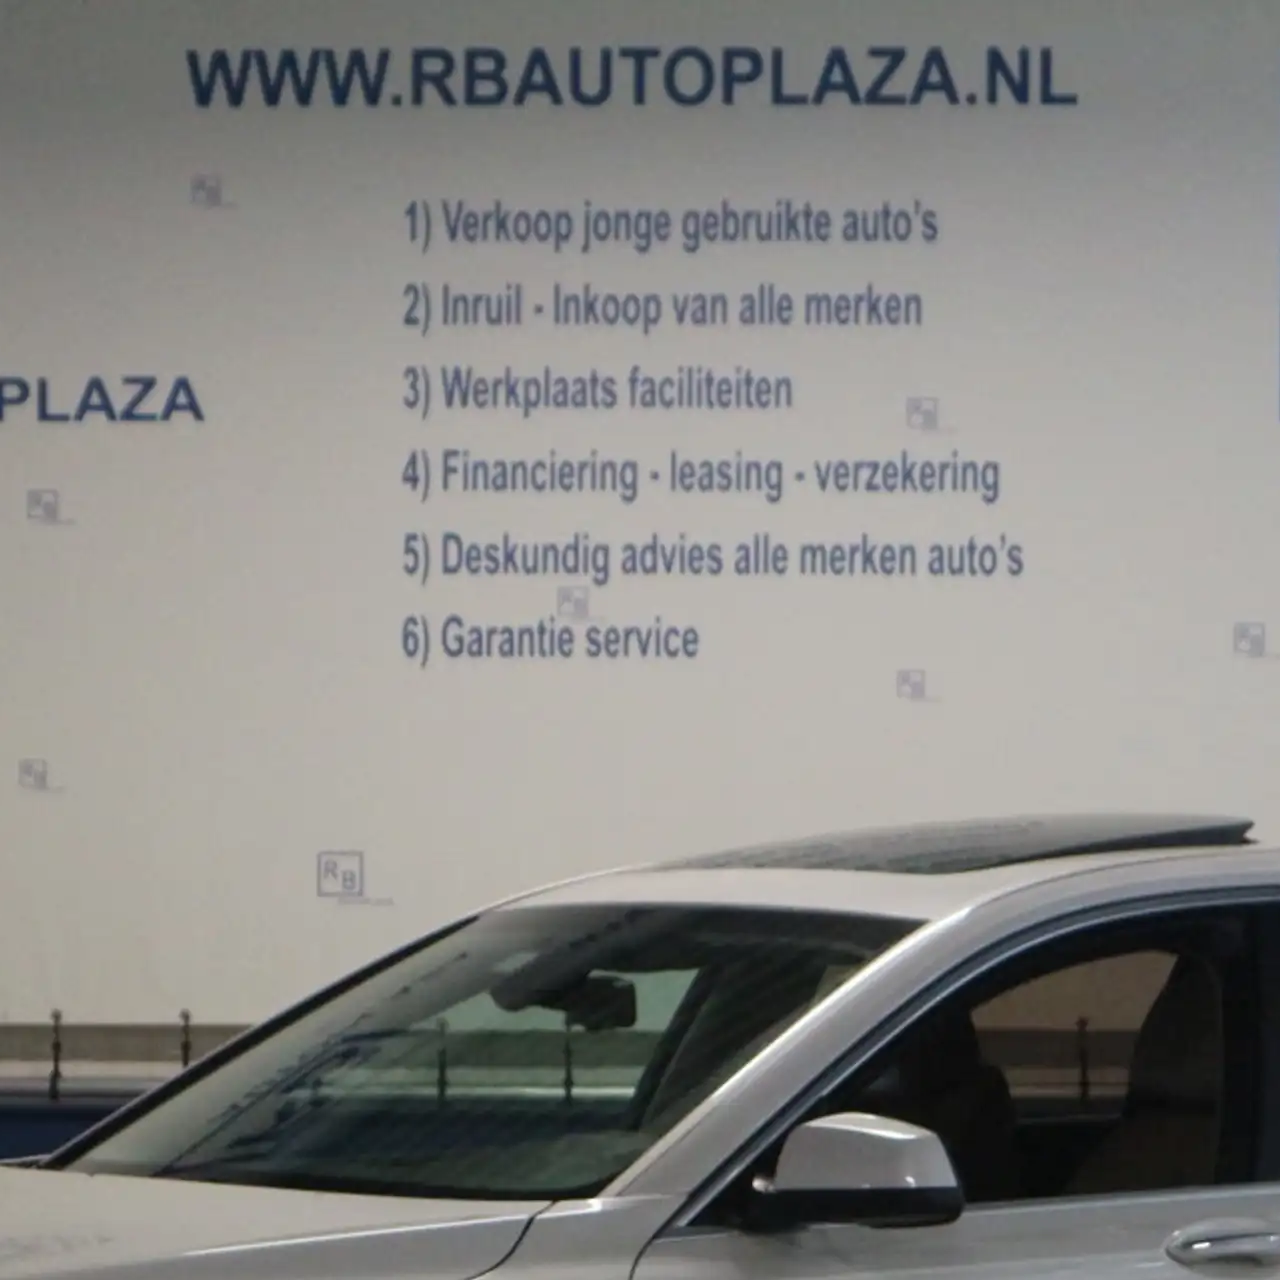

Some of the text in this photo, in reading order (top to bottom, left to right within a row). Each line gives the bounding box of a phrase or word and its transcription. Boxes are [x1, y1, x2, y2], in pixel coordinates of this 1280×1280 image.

[186, 46, 1078, 108] WWW.RBAUTOPLAZA.NL
[404, 199, 939, 254] 1) Verkoop jonge gebruikte auto's
[403, 282, 432, 337] 2)
[441, 282, 523, 326] Inruil
[553, 282, 662, 336] Inkoop
[672, 293, 728, 327] van
[739, 283, 794, 327] alle
[804, 282, 922, 327] merken
[403, 365, 793, 420] 3) Werkplaats faciliteiten
[402, 449, 431, 503] 4)
[442, 449, 638, 505] Financiering
[670, 449, 783, 504] leasing
[814, 449, 1000, 505] verzekering
[403, 532, 1025, 587] 5) Deskundig advies alle merken auto's
[402, 615, 699, 669] 6) Garantie service
